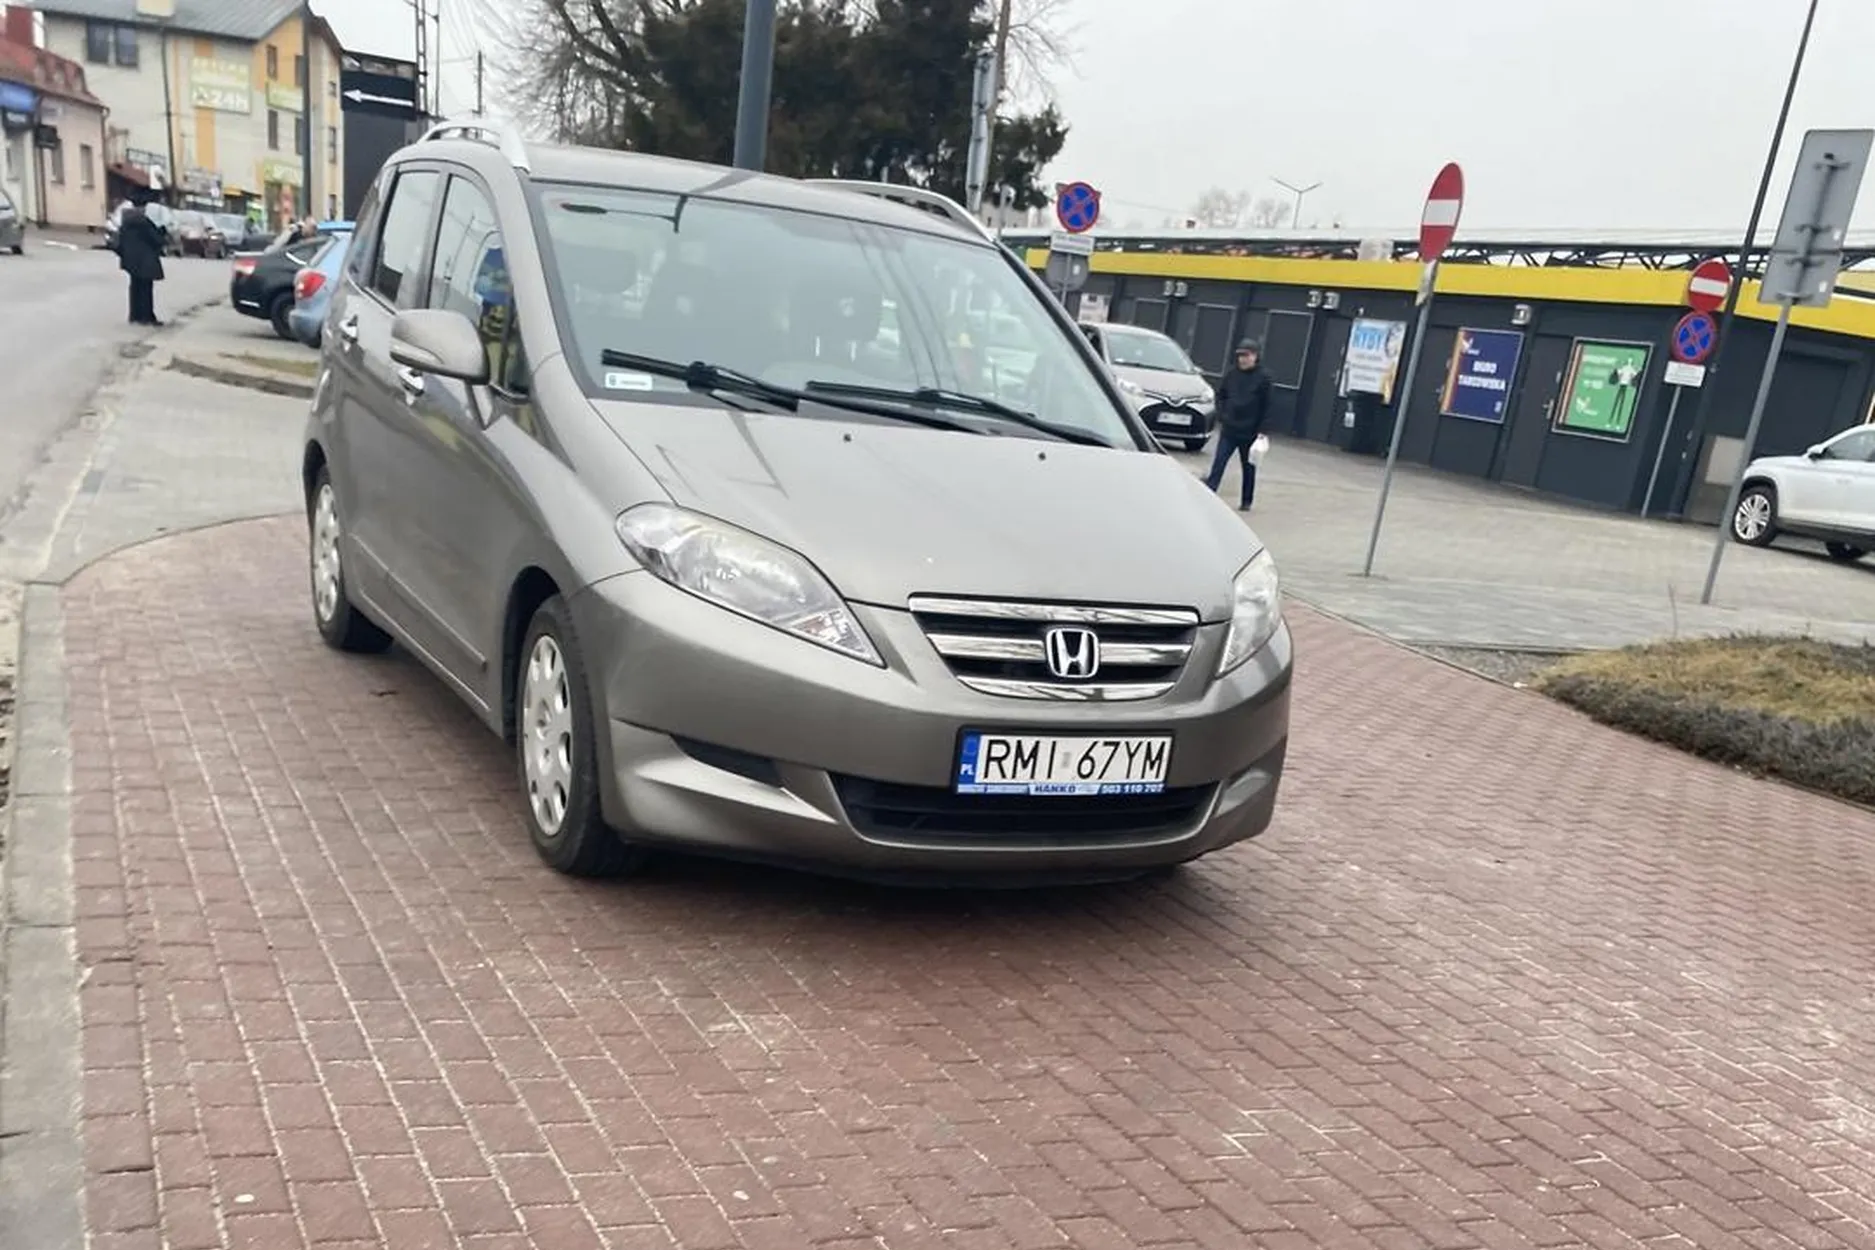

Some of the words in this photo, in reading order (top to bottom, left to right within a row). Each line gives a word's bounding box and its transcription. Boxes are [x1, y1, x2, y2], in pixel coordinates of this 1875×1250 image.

[960, 764, 974, 775] PL
[984, 739, 1057, 779] RMI
[1077, 741, 1166, 779] 67YM
